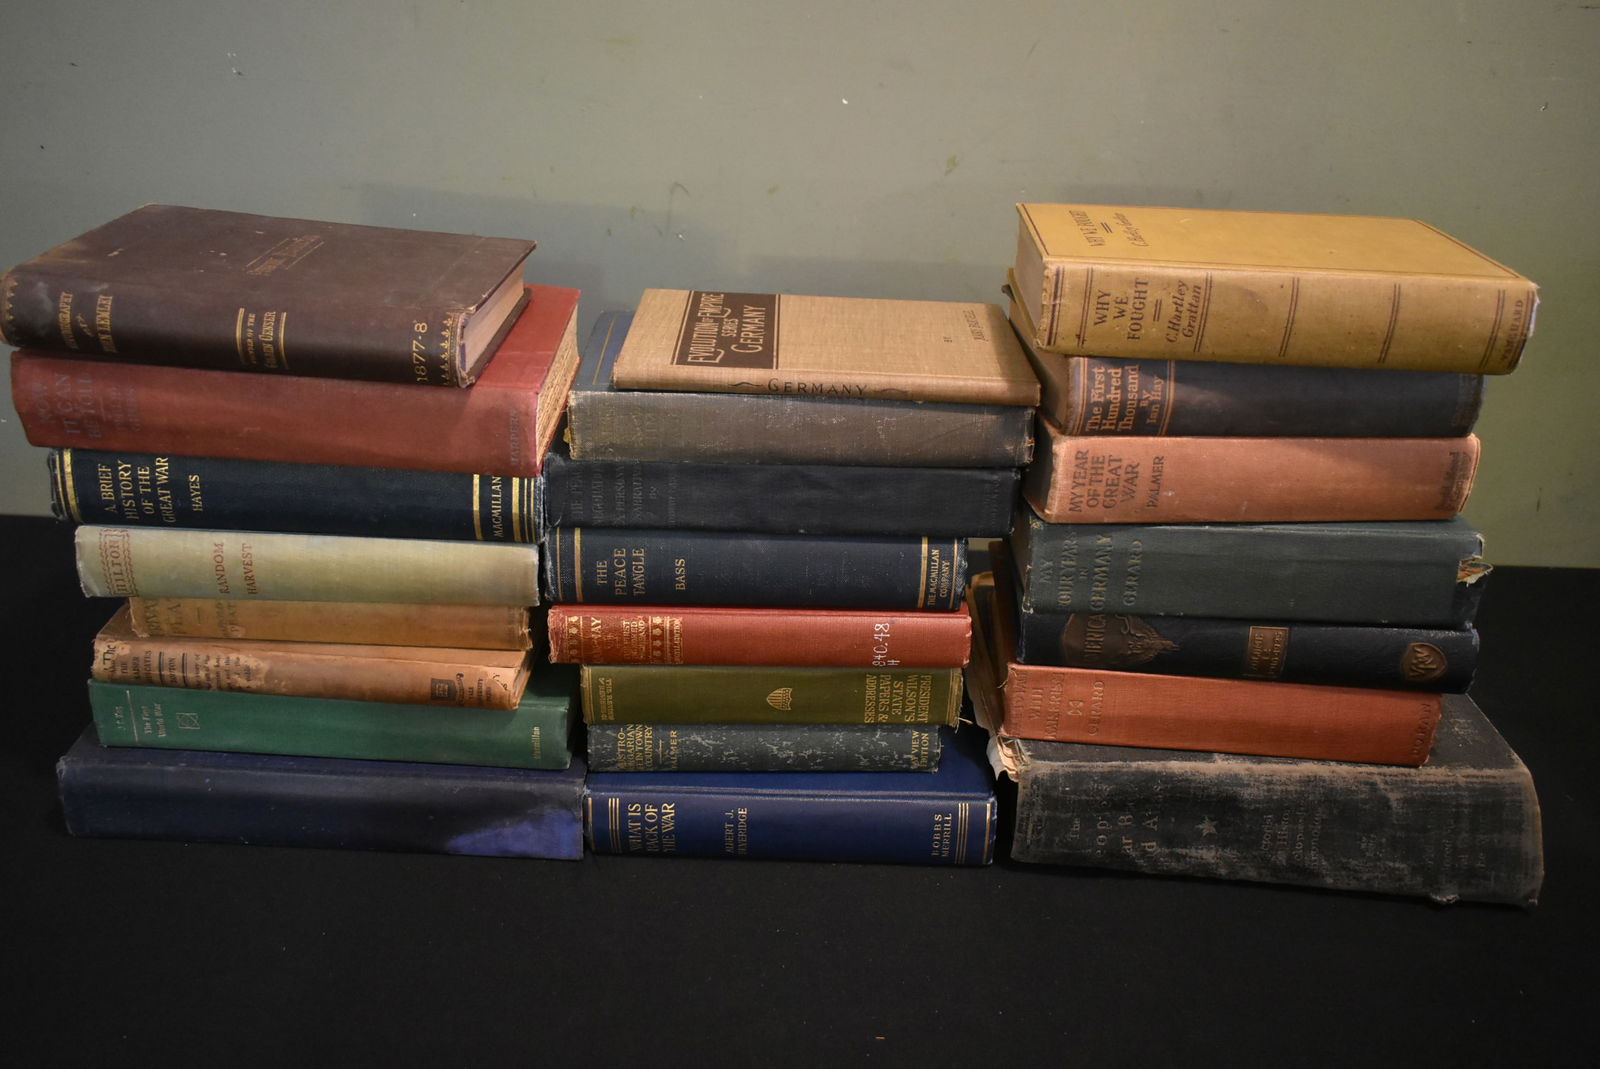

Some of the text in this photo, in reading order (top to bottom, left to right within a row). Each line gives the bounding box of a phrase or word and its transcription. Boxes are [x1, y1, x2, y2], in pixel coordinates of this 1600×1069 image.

[698, 293, 731, 318] EMPIRE
[721, 318, 738, 337] SERIES
[730, 305, 768, 353] GERMANY
[1094, 289, 1112, 326] WHY
[1113, 296, 1129, 320] WE
[1127, 278, 1149, 340] FOUGHT
[1182, 284, 1202, 338] Grattan
[687, 320, 725, 364] EVOLUTION
[767, 377, 868, 397] GERMANY
[1085, 366, 1106, 432] The First
[1100, 367, 1122, 431] Hundred
[1117, 364, 1140, 432] Thousand
[1146, 376, 1164, 424] Ian Hay
[97, 463, 117, 514] A BRIEF
[117, 458, 140, 521] HISTORY
[137, 465, 155, 515] OF THE
[155, 456, 177, 523] GREAT WAR
[188, 473, 204, 512] HAYES
[568, 465, 584, 496] PEAC
[615, 463, 625, 511] PERSONA
[1069, 449, 1089, 513] MY YEAR
[1086, 455, 1105, 508] OF THE
[1102, 454, 1122, 509] GREAT
[1120, 463, 1140, 503] WAR
[1146, 455, 1165, 508] PALMER
[491, 475, 504, 538] MACMILLAN
[109, 538, 128, 594] HILTON
[213, 541, 231, 595] RANDOM
[241, 542, 258, 595] HARVEST
[596, 559, 608, 585] THE
[613, 547, 627, 596] PEACE
[632, 547, 646, 596] TANGLE
[675, 558, 687, 591] BASS
[930, 549, 940, 593] MACMILLAN
[940, 560, 950, 598] COMPANY
[1088, 535, 1114, 611] GERMANY
[1122, 540, 1144, 606] GERARD
[1057, 575, 1074, 607] OUR
[590, 616, 602, 638] HAY
[872, 622, 890, 667] 840.48
[1084, 614, 1107, 660] MERICA
[864, 674, 878, 724] ADDRESSES
[878, 674, 892, 723] PAPERS &
[892, 680, 904, 716] STATE
[904, 674, 919, 723] WILSON'S
[917, 674, 932, 724] PRESIDENT
[617, 728, 626, 768] USTRO-
[636, 724, 644, 751] TOWN
[644, 725, 653, 767] COUNTRY
[670, 730, 679, 769] PALMER
[911, 730, 920, 754] VIEW
[628, 803, 643, 852] WHAT IS
[644, 803, 659, 852] BACK OF
[661, 802, 676, 853] THE WAR
[724, 809, 734, 818] J.
[737, 807, 748, 855] BEVERIDGE
[931, 813, 943, 856] BOBBS
[941, 813, 953, 857] MERRILL
